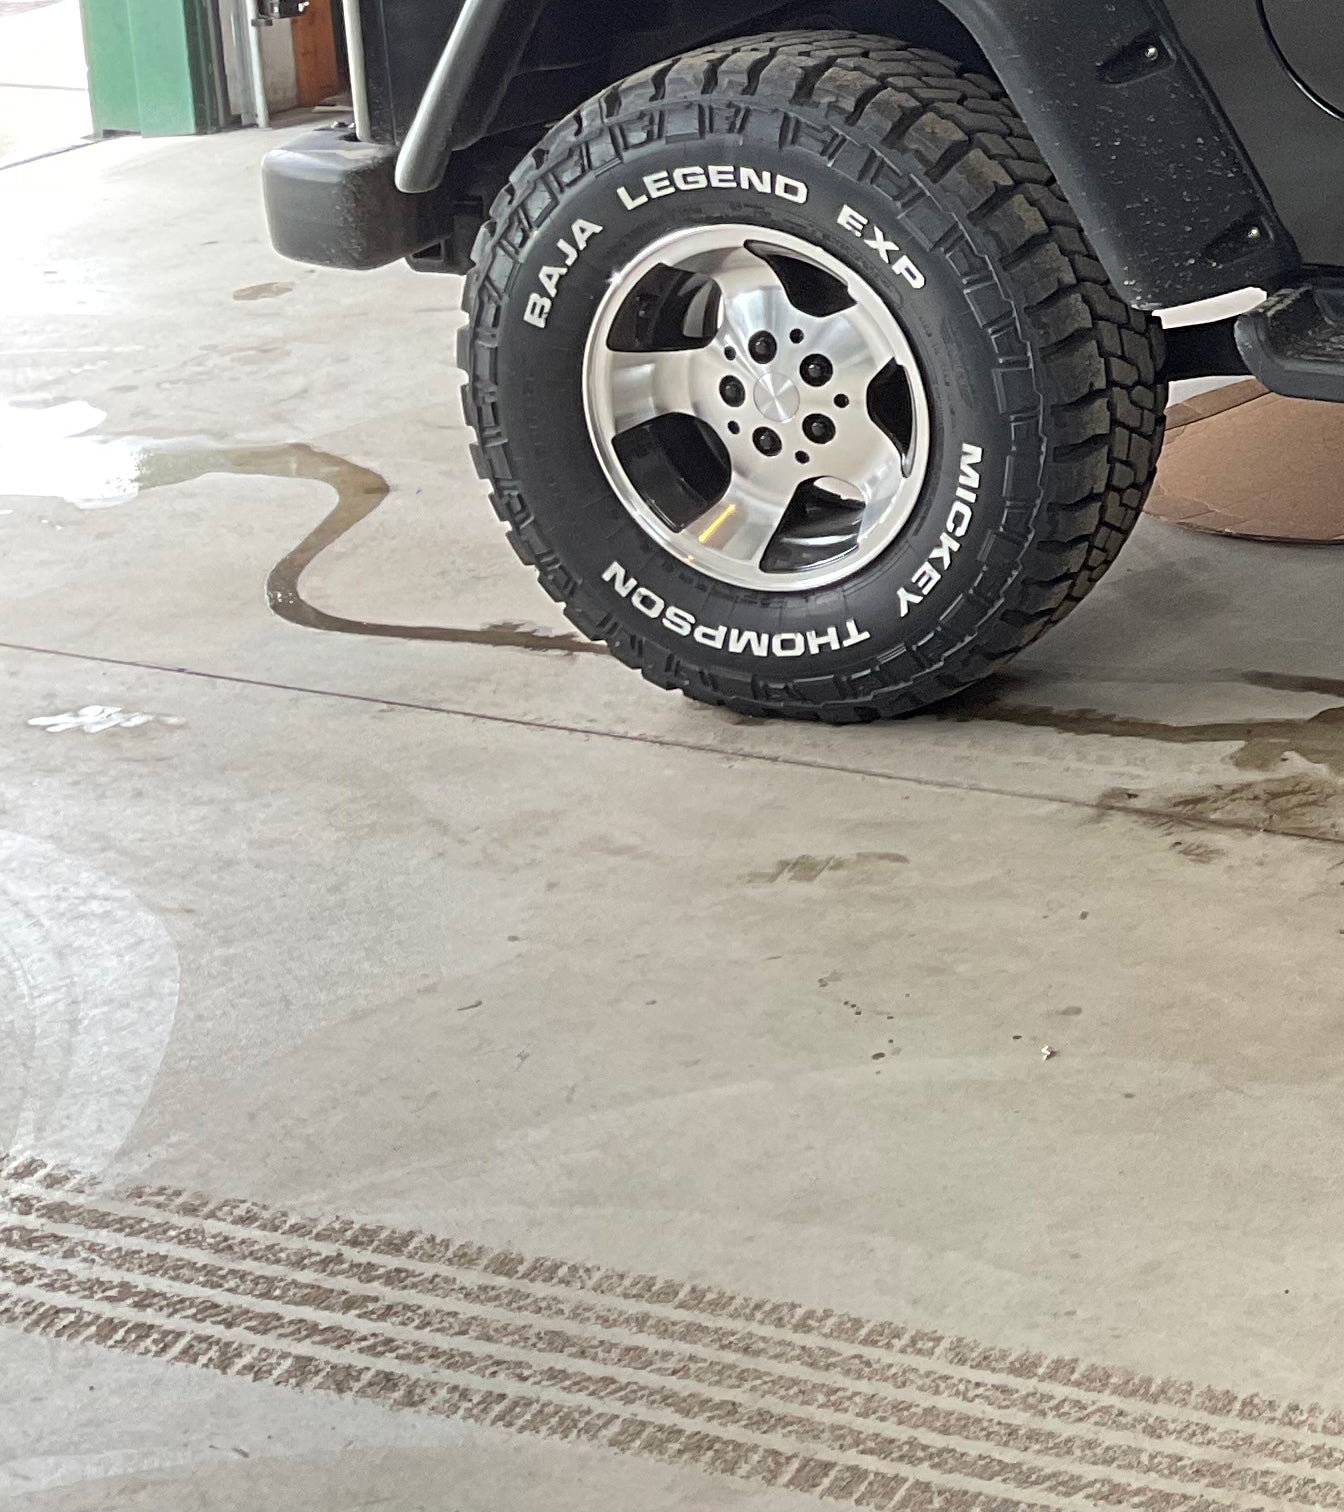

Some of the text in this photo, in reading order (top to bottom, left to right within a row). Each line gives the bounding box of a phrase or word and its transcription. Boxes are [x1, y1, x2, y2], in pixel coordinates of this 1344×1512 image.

[523, 165, 926, 330] BAJA LEGEND EXP
[600, 442, 983, 657] MICKEY THOMPSON
